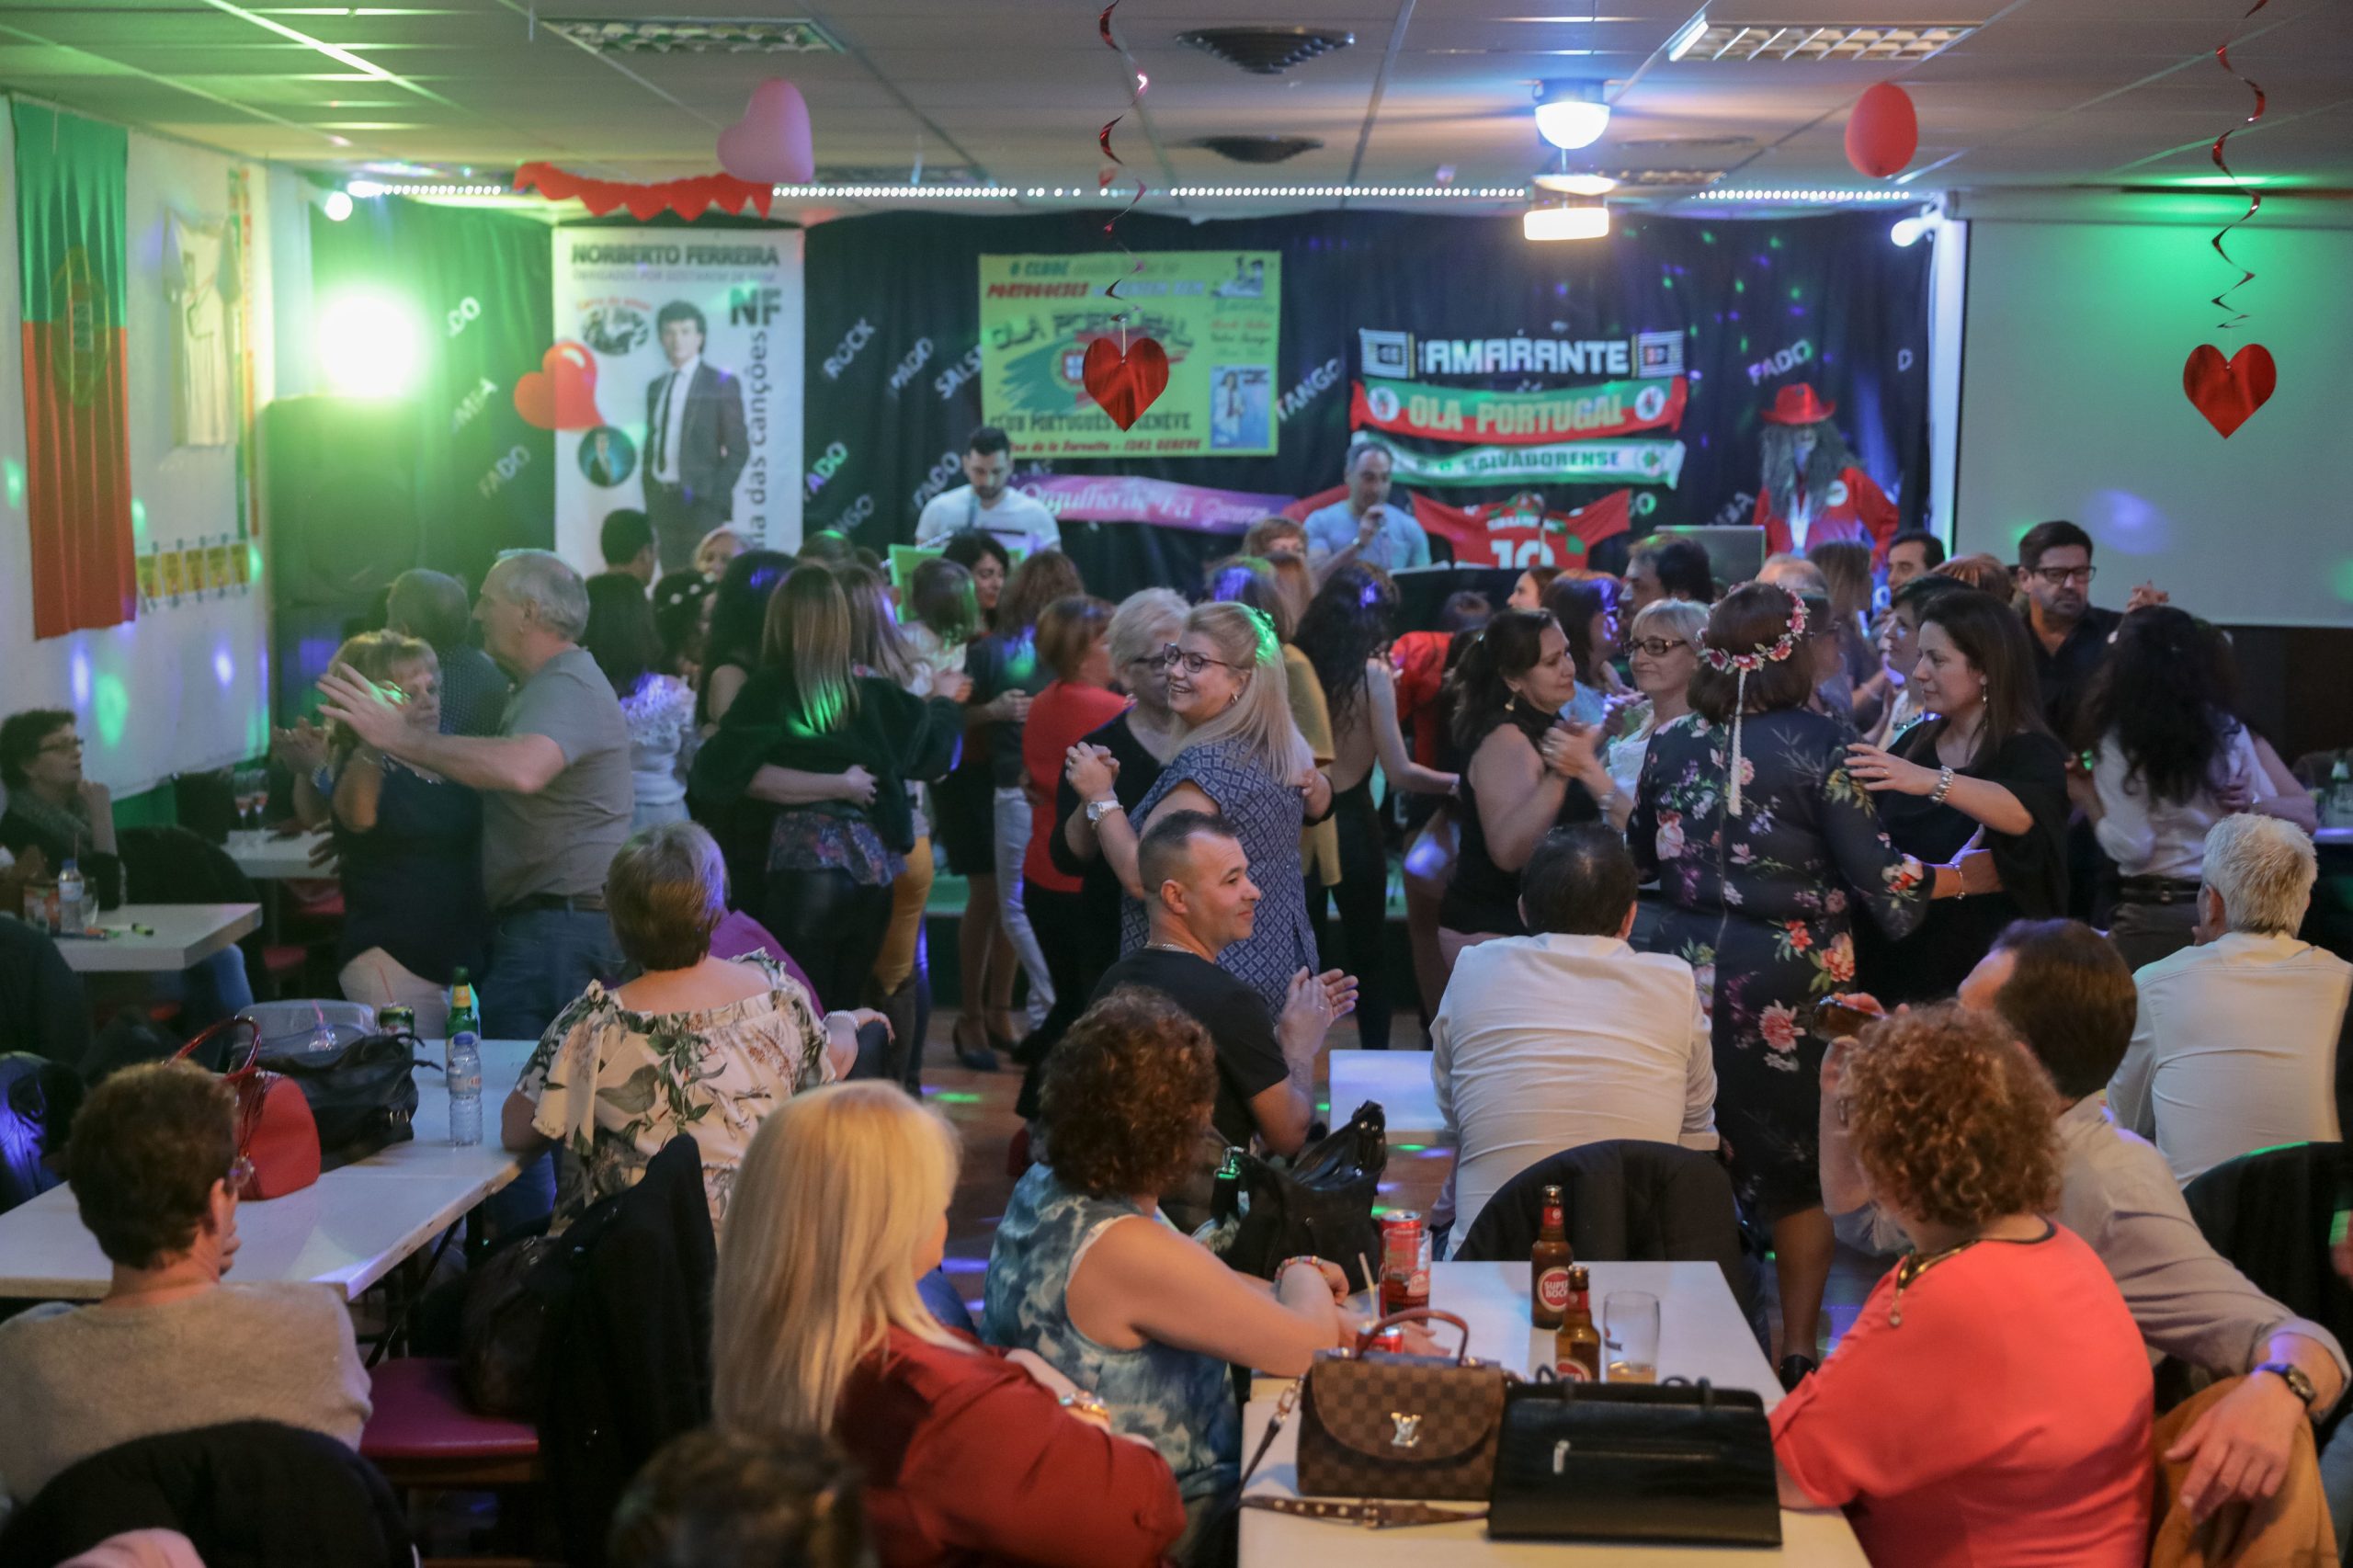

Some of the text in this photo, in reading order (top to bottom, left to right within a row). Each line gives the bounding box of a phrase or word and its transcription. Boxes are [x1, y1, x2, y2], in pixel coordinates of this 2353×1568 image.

[572, 244, 780, 267] NORBERTO FERREIRA
[730, 287, 782, 325] NF
[986, 281, 1089, 299] PORTUGUESES
[823, 318, 875, 381] ROCK
[935, 344, 982, 400] SALS
[1425, 336, 1630, 376] AMARANTE
[1747, 338, 1814, 387] FADO
[745, 329, 772, 448] canções
[1276, 358, 1342, 422] TANGO
[1408, 394, 1625, 436] OLA PORTUGAL
[477, 444, 532, 500] FADO
[745, 454, 767, 506] das
[1544, 1279, 1568, 1289] SUPE
